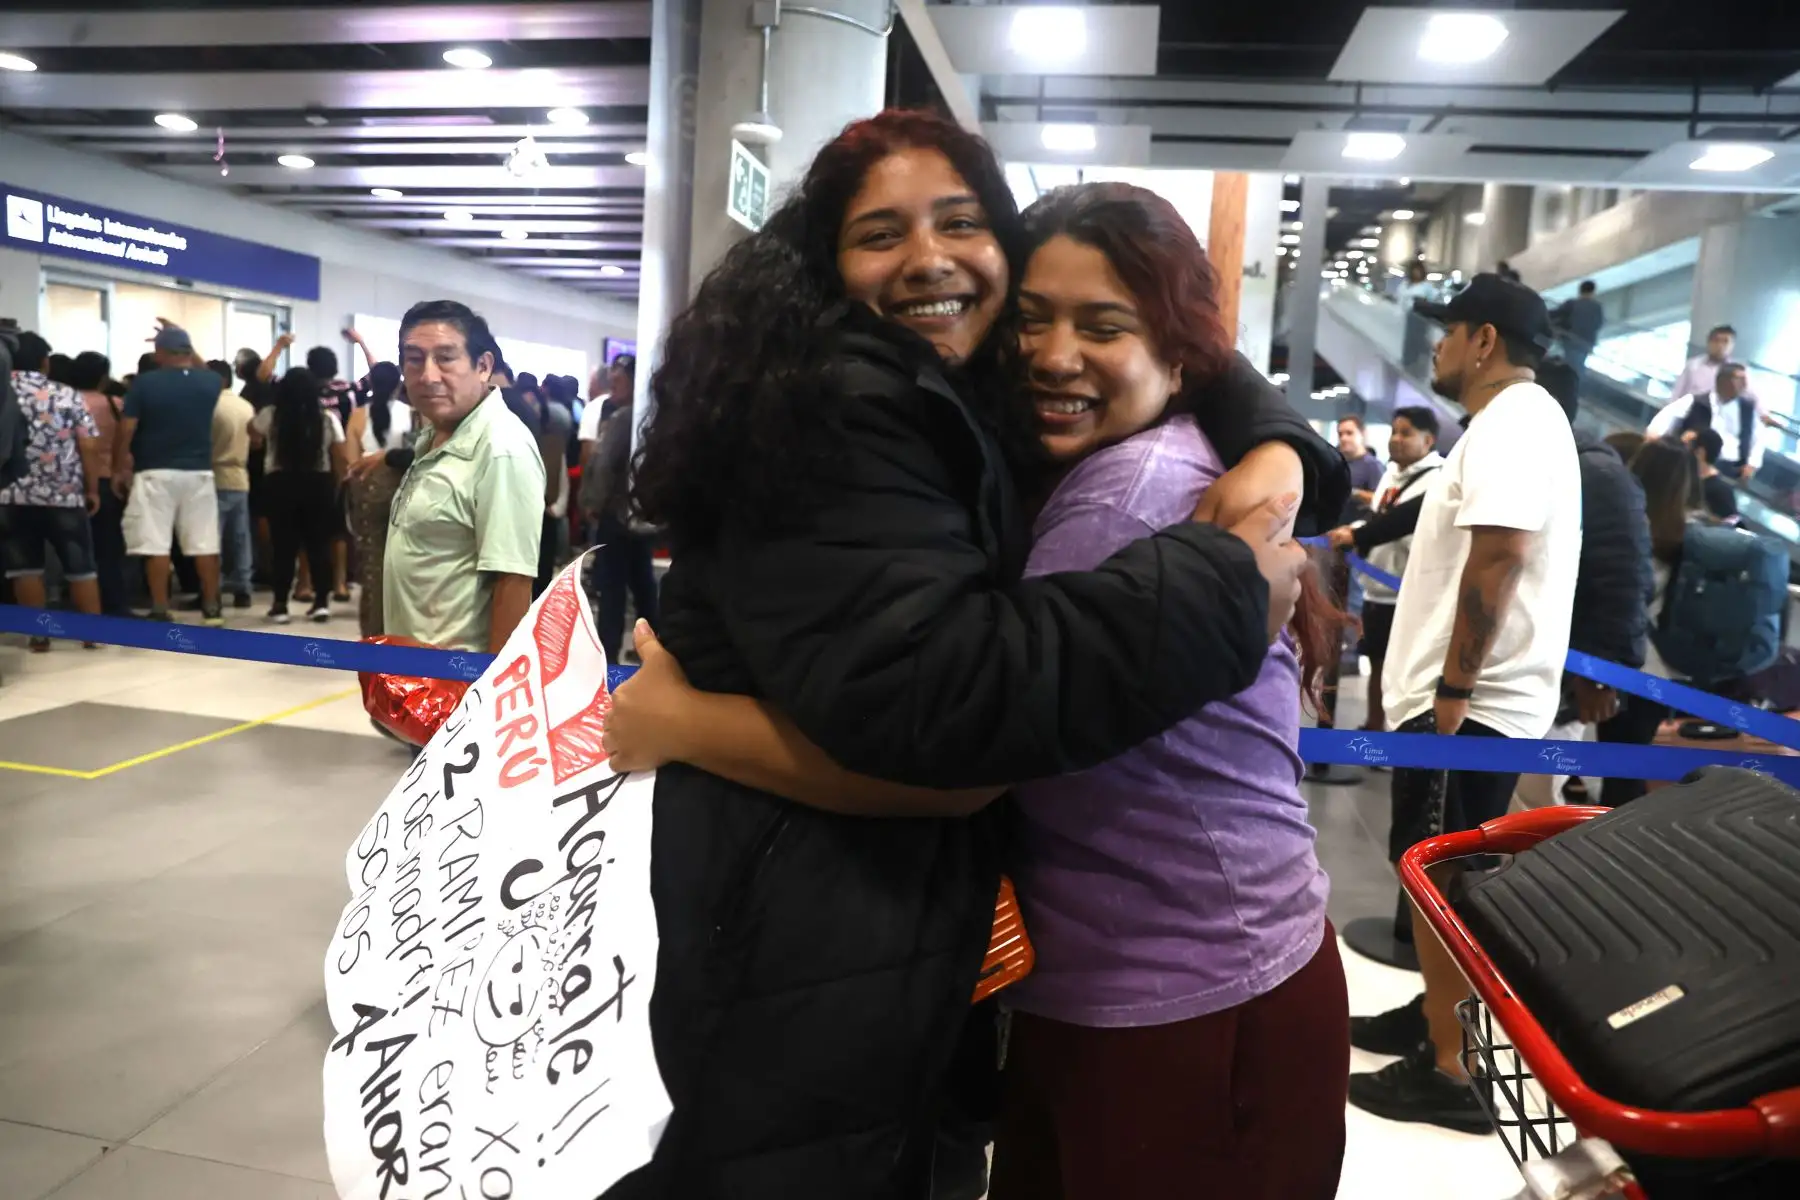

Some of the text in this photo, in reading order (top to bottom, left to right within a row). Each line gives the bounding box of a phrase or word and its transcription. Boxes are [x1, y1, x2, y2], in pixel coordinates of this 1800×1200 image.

[443, 742, 480, 801] 2
[493, 655, 548, 789] PERÚ
[360, 1033, 418, 1200] AHOR
